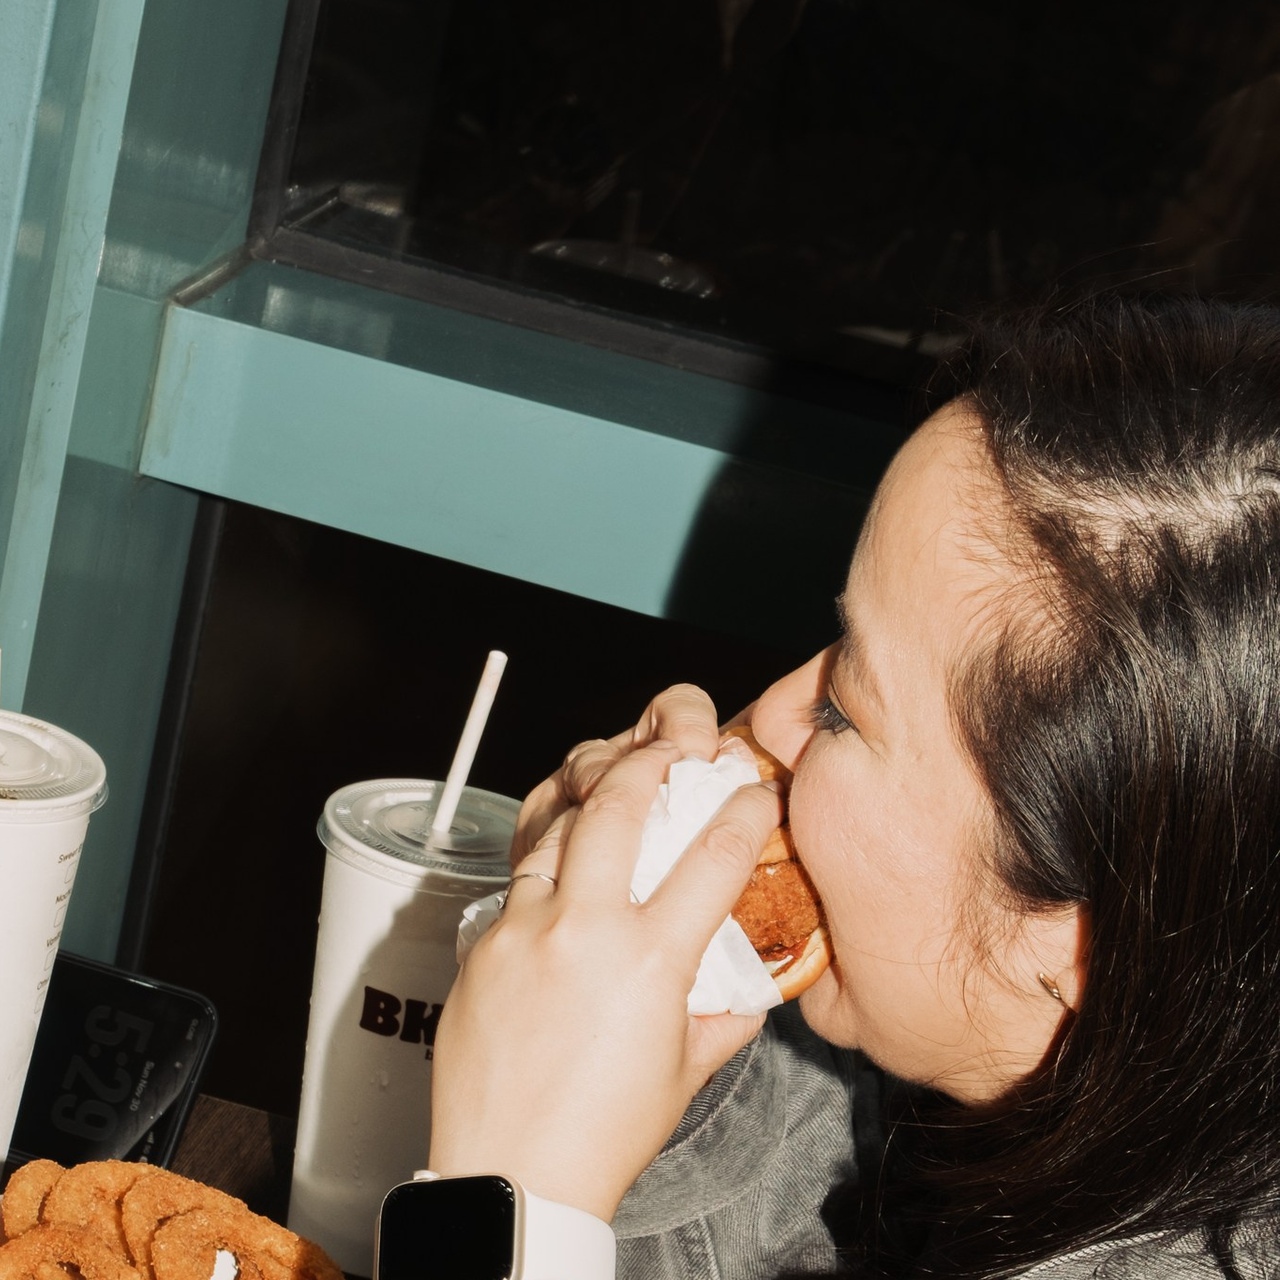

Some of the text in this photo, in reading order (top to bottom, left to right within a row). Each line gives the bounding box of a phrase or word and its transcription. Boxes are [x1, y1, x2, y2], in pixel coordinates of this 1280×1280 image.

[50, 1004, 155, 1142] 5:29
[129, 1060, 155, 1112] Sun Nov 30
